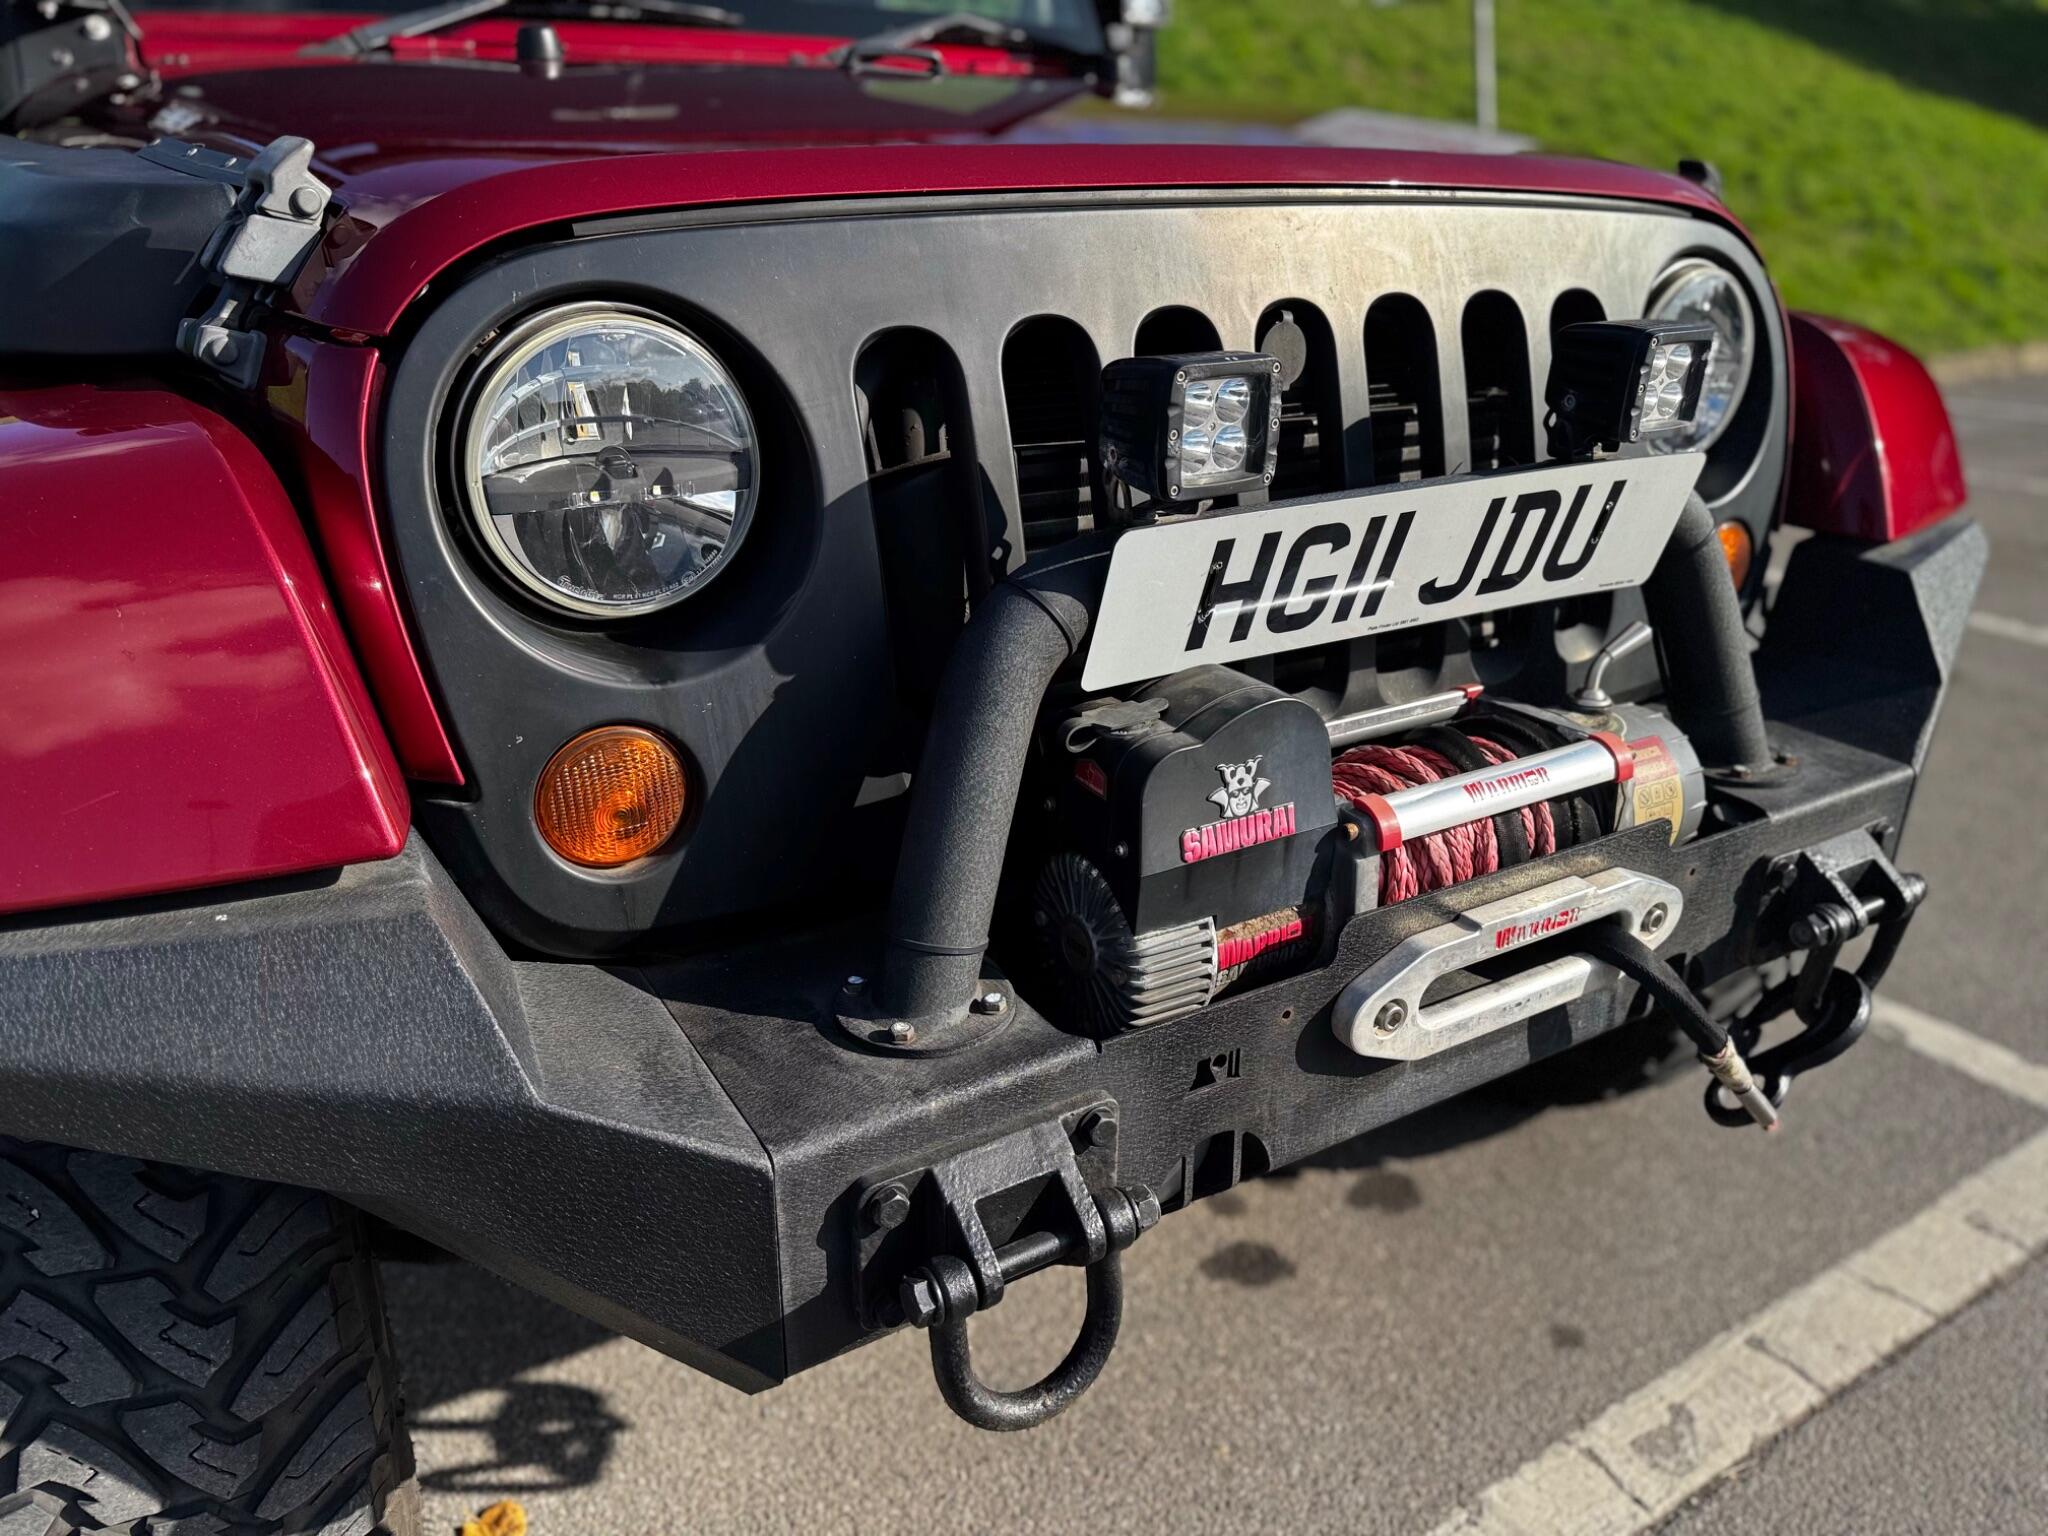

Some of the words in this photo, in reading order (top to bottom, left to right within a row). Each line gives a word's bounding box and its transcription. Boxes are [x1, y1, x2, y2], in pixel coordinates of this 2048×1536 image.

[1418, 480, 1627, 605] JDU
[1462, 766, 1550, 803] WARRIOR
[1182, 802, 1296, 863] SAMURAI
[1217, 918, 1304, 970] WARRIO
[1495, 906, 1580, 949] WARRIOR
